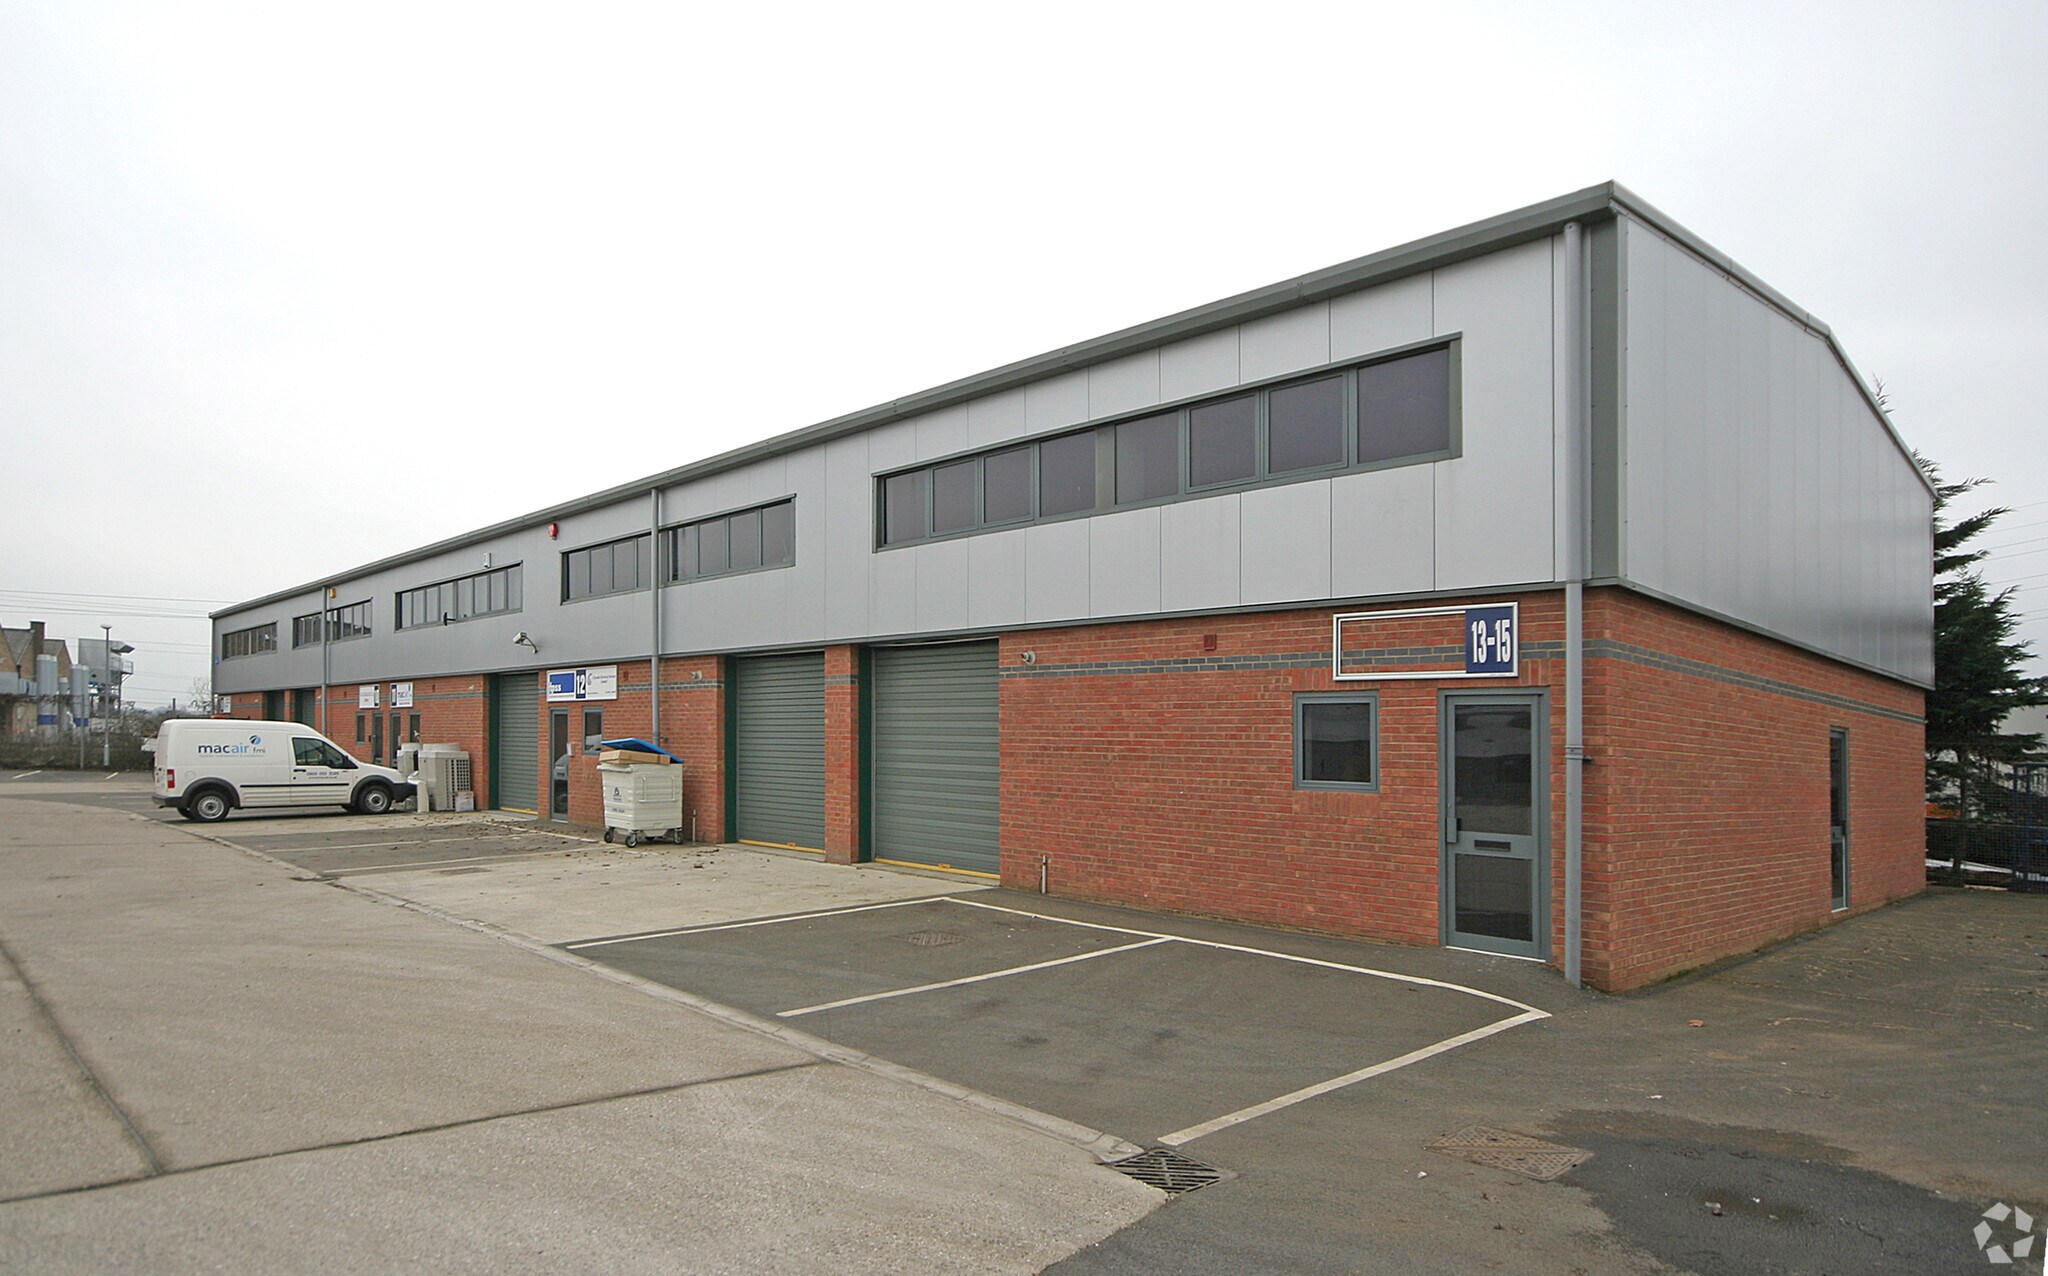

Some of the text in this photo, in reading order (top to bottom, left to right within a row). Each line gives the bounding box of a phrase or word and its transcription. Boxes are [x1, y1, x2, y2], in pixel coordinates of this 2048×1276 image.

[1471, 619, 1511, 663] 13-15
[577, 675, 585, 694] 12
[198, 742, 250, 754] macair
